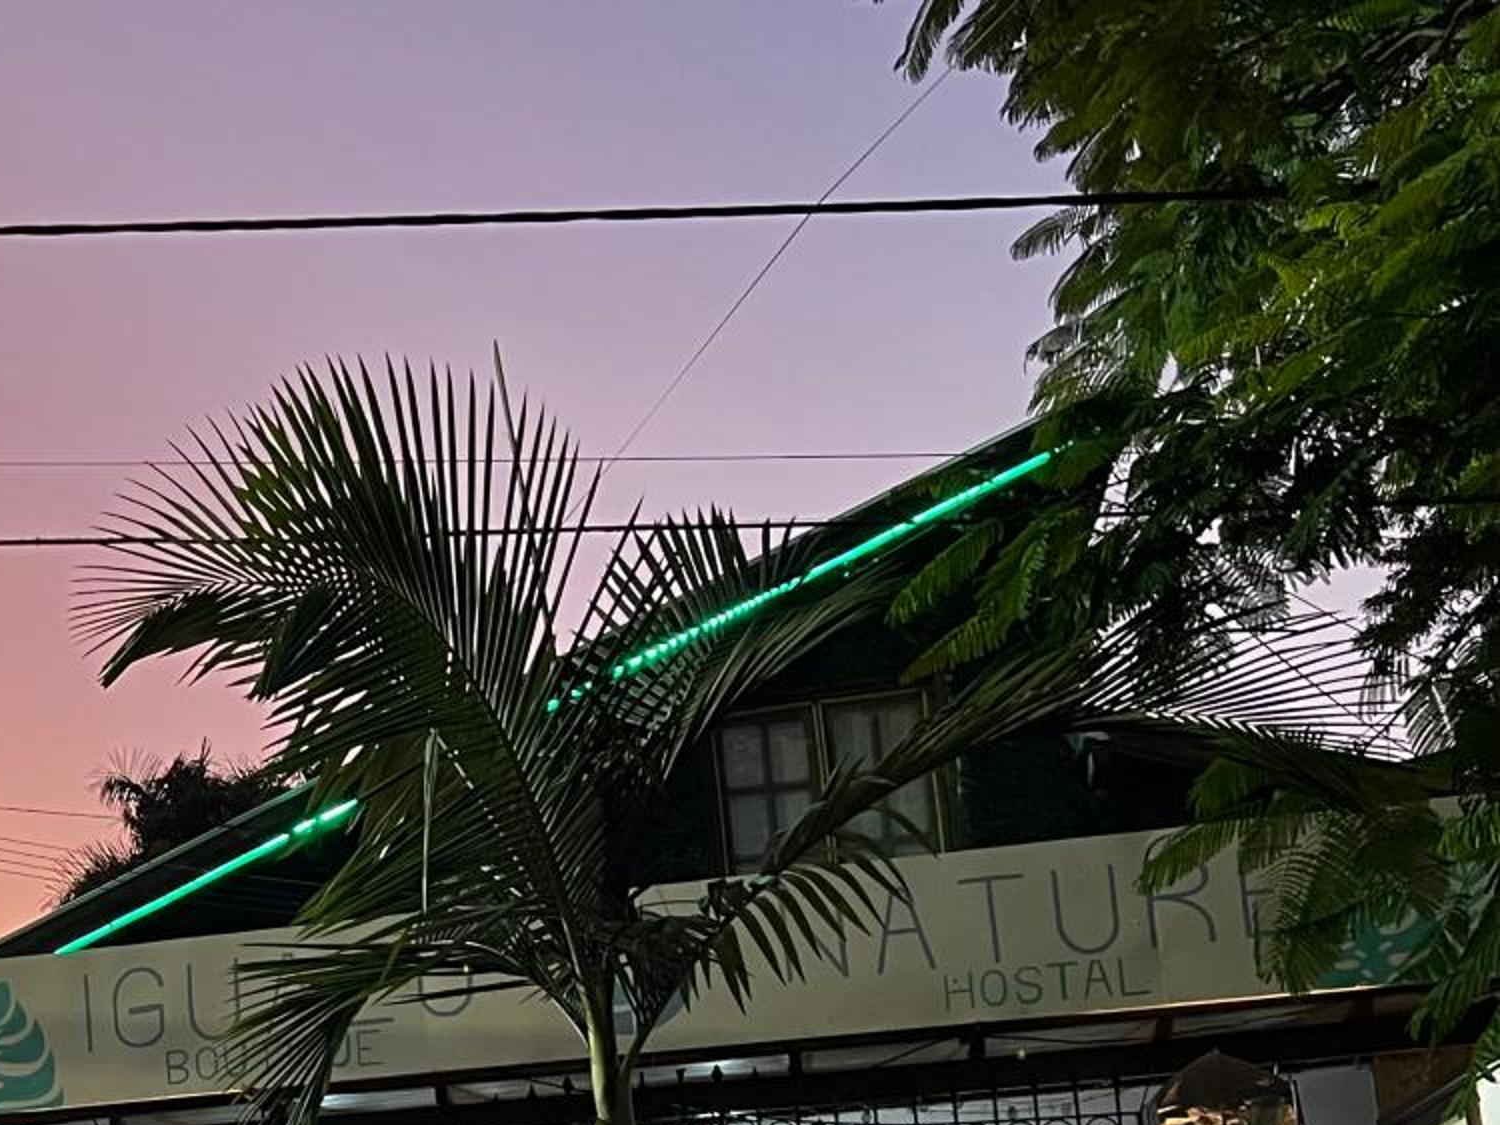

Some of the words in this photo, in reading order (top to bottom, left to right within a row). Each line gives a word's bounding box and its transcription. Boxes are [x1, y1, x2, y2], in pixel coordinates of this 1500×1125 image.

[83, 934, 476, 1054] IGUU
[943, 957, 1151, 1012] HOSTAL
[165, 1028, 385, 1085] BOUUE
